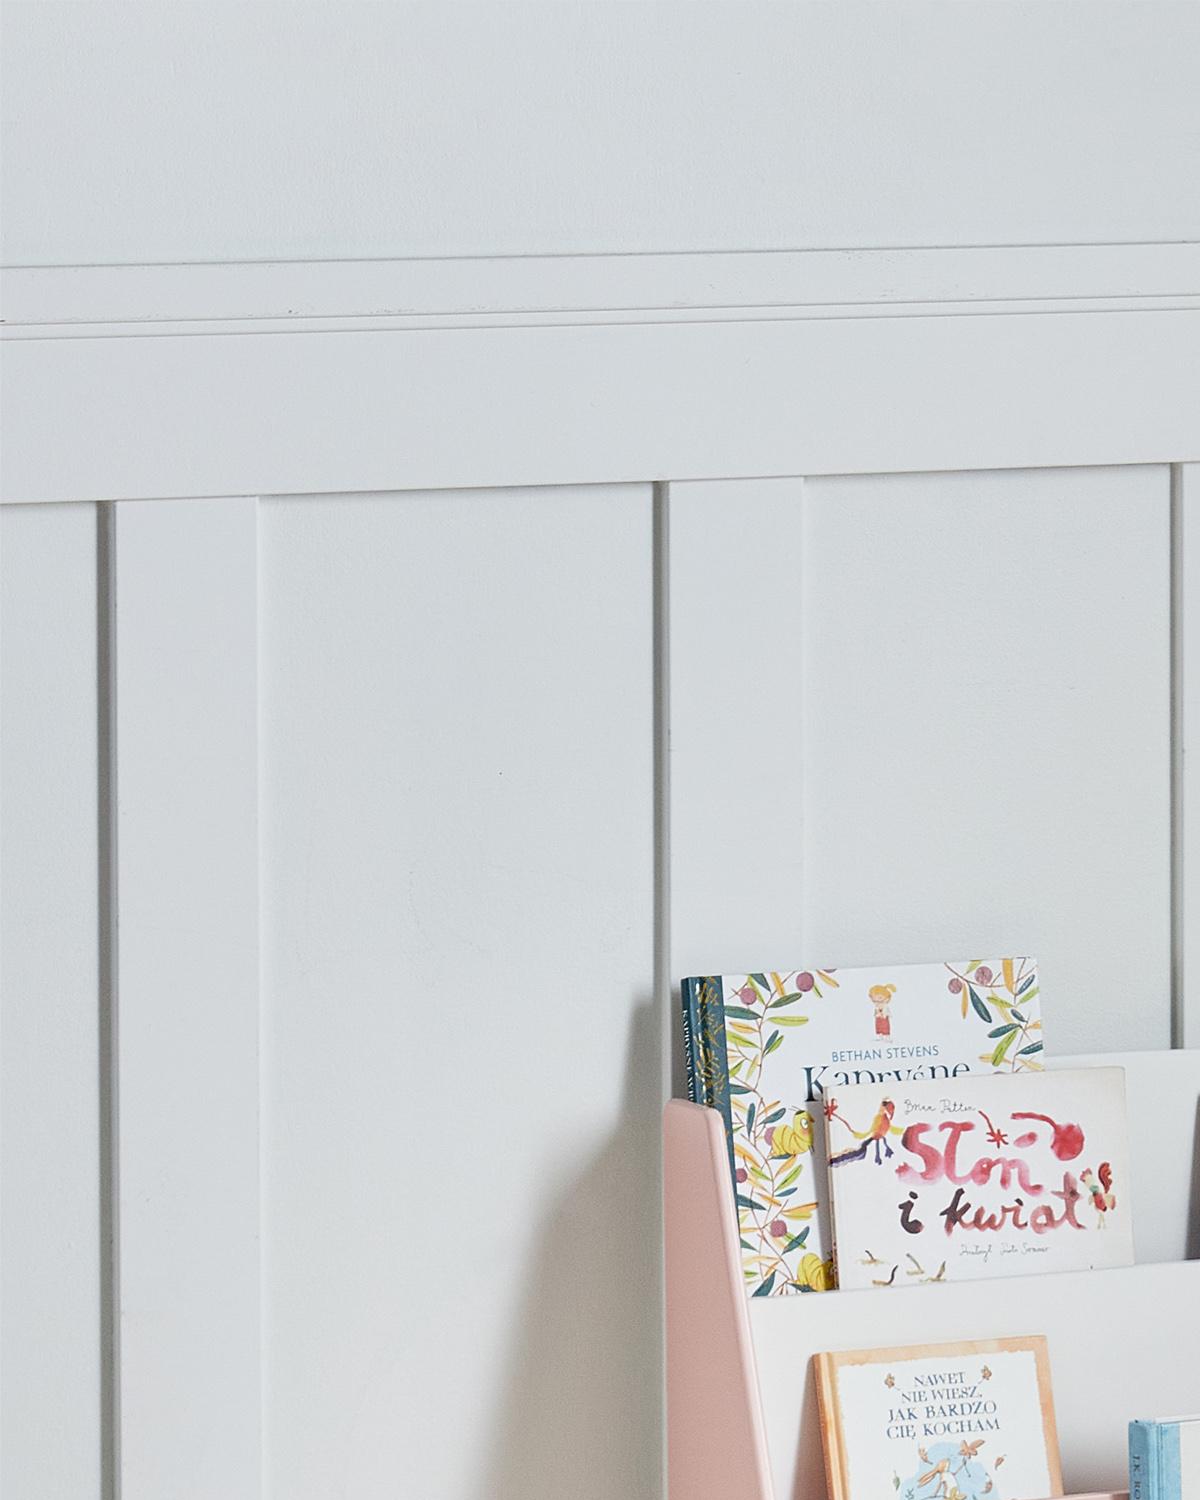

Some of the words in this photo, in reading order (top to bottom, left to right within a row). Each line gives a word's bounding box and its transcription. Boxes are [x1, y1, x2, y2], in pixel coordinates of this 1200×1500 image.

[832, 1049, 882, 1063] BETHAN
[887, 1045, 939, 1060] STEVENS
[898, 1191, 925, 1235] i
[940, 1171, 1087, 1237] kwiat
[914, 1371, 967, 1387] NAWET
[901, 1391, 928, 1404] NIE
[888, 1408, 918, 1423] JAK
[924, 1400, 997, 1419] BARDZO
[886, 1425, 916, 1440] CIĘ
[923, 1418, 1000, 1437] KOCHAM
